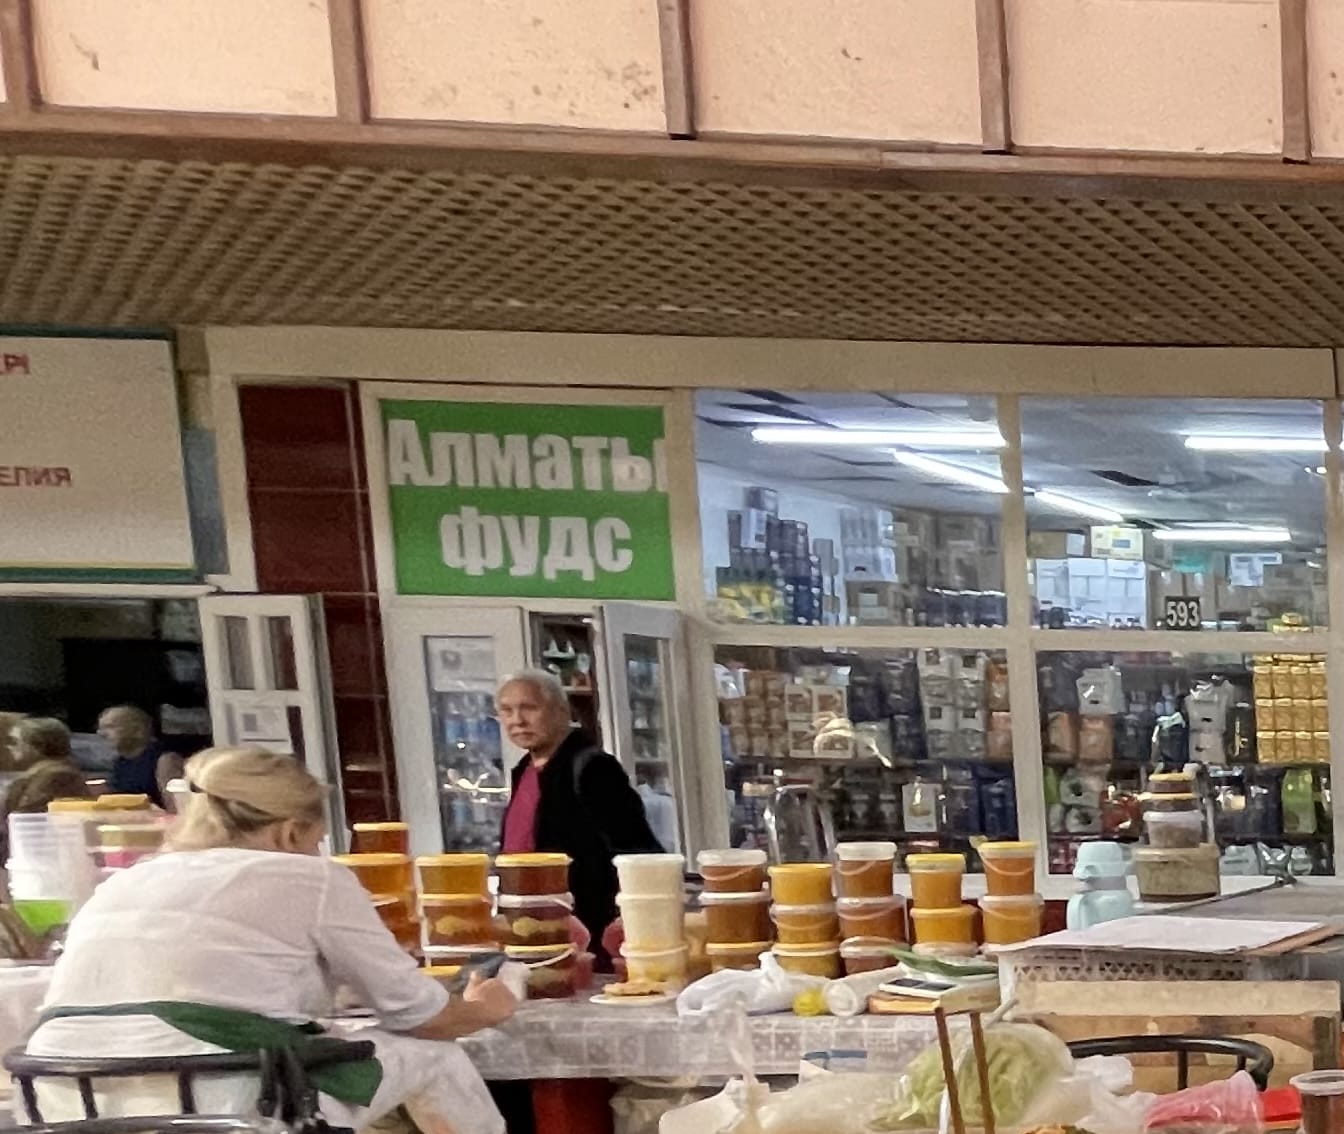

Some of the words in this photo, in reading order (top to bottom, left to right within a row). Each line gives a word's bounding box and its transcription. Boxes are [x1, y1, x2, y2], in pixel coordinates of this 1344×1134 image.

[388, 419, 668, 492] Алматы
[440, 506, 633, 581] фудс
[1167, 601, 1199, 627] 593
